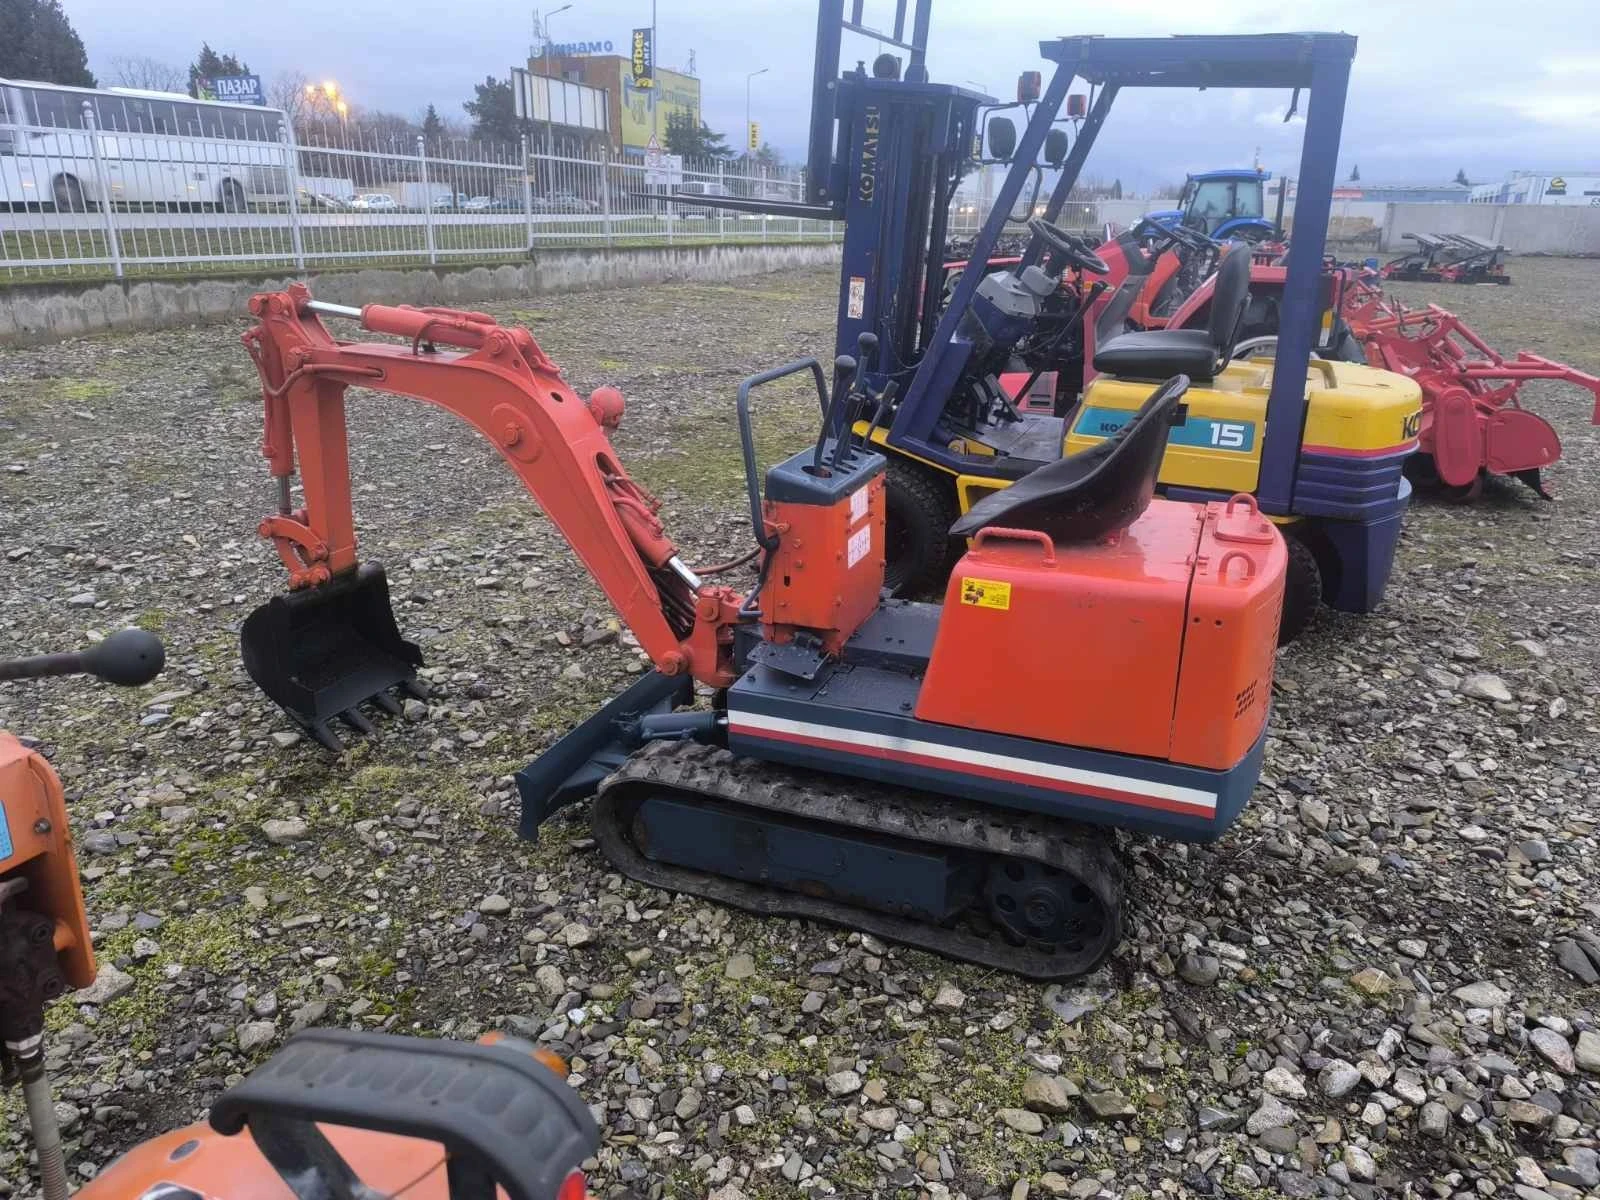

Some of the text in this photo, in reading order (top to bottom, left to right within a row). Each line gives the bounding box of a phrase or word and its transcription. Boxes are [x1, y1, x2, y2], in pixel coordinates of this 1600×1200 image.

[633, 32, 644, 74] efbet
[217, 79, 257, 95] ПАЗАР
[1210, 422, 1245, 448] 15
